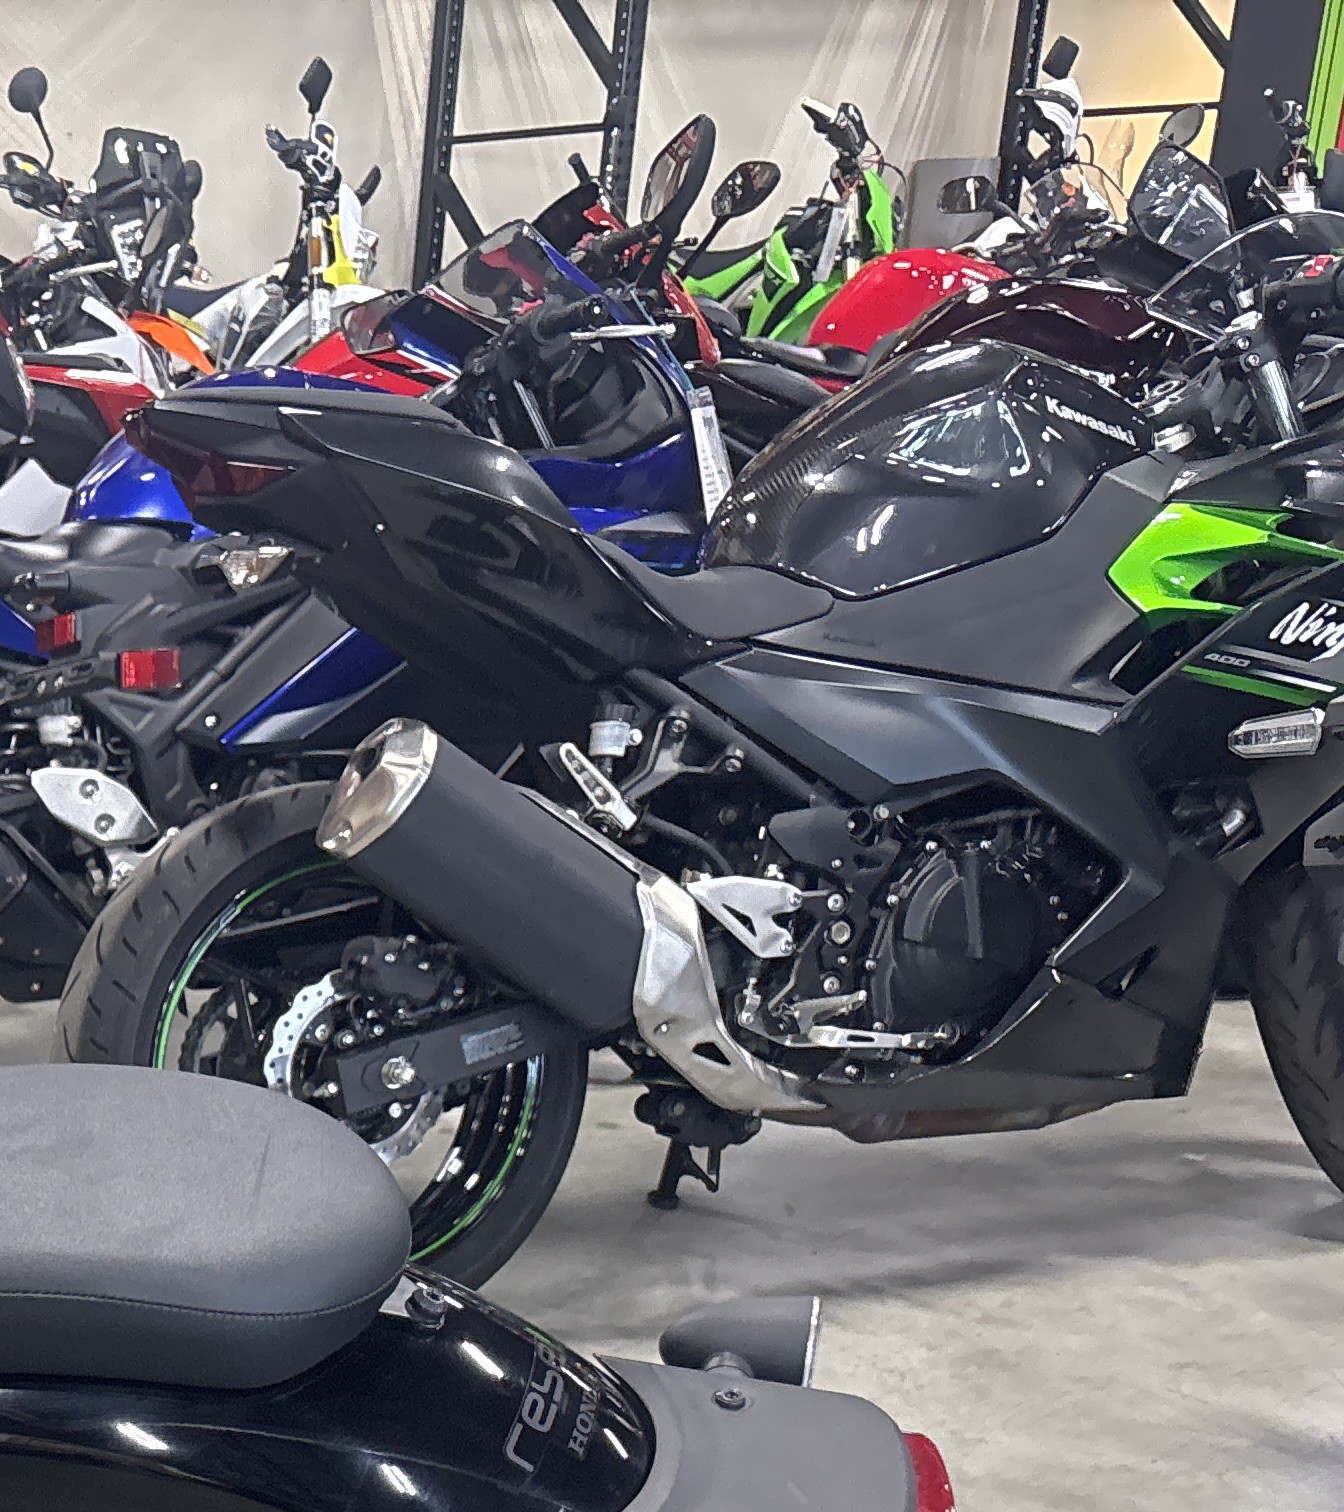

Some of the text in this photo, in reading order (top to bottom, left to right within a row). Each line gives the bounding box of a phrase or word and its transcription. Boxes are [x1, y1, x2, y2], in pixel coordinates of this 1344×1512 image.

[1044, 394, 1137, 447] Kawasaki
[1269, 601, 1344, 664] Nin
[1203, 653, 1252, 668] 400
